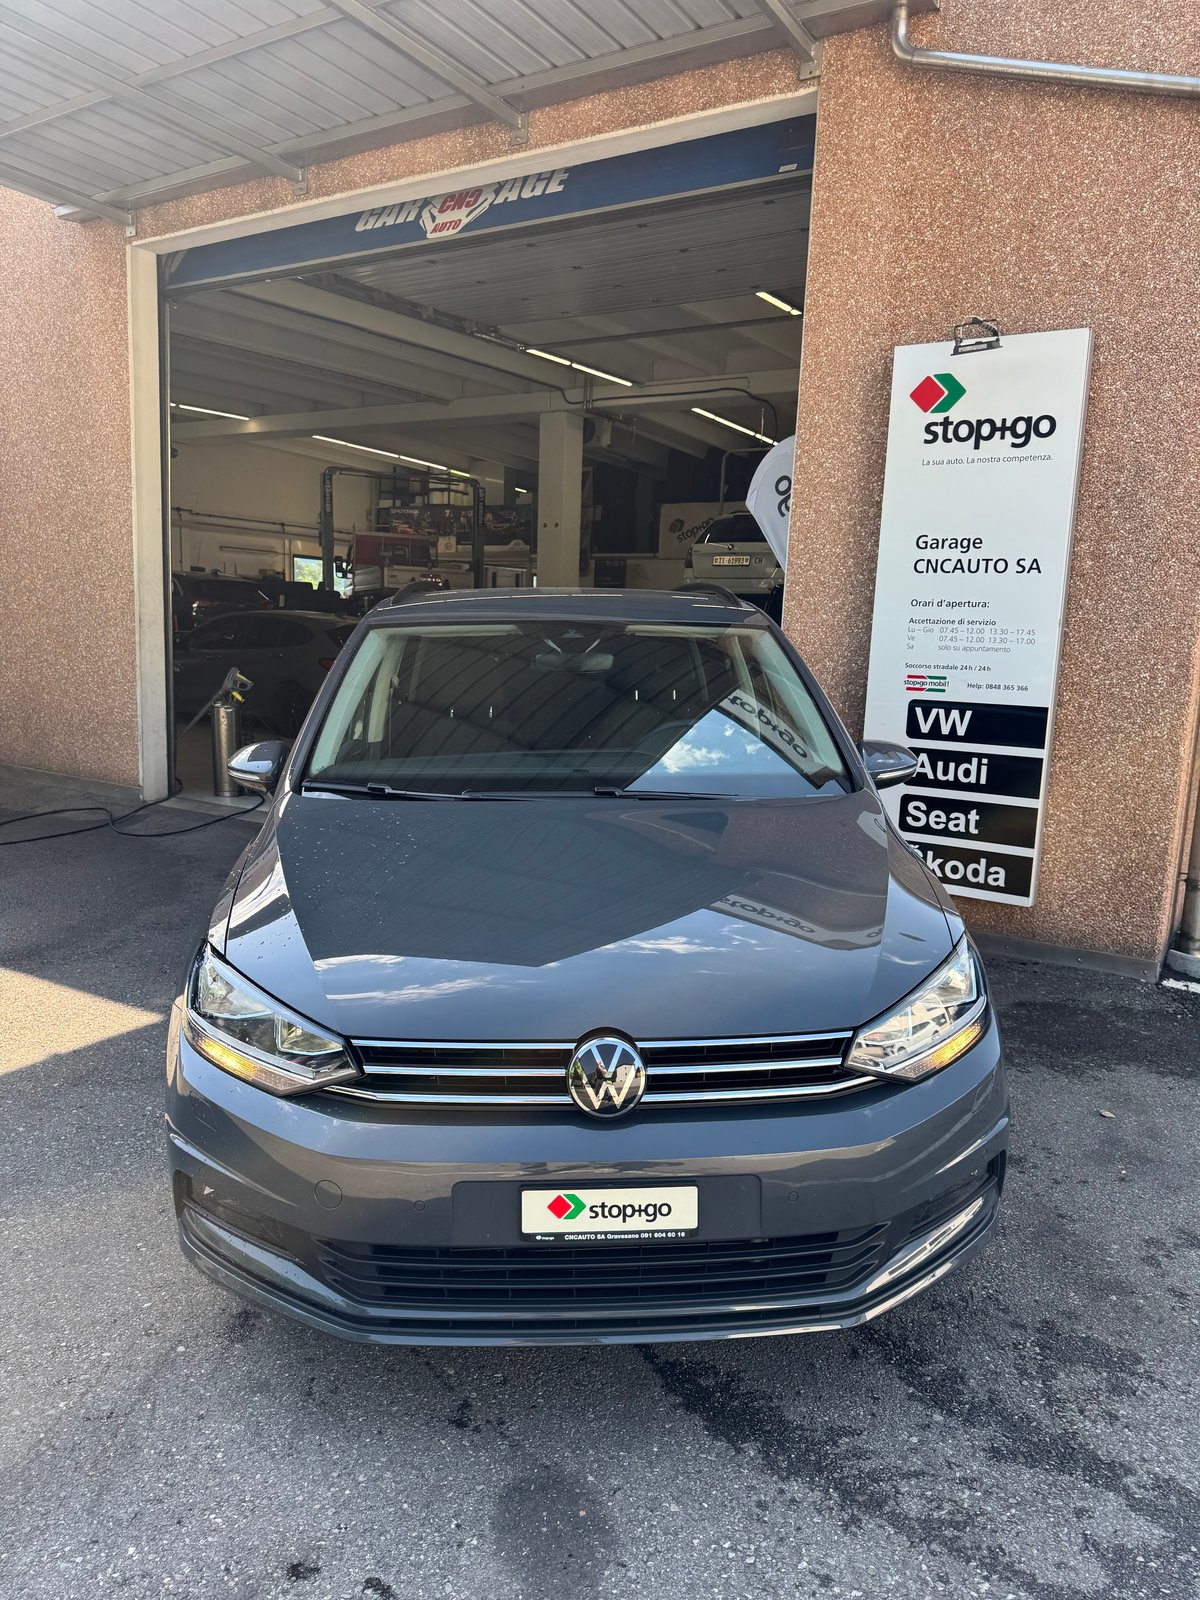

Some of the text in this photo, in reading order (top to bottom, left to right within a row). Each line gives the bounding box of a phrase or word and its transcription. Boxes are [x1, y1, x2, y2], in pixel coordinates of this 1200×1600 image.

[430, 218, 463, 235] AUTO
[923, 414, 1057, 451] stop+go
[966, 456, 975, 464] La
[976, 456, 1001, 464] nostra
[1002, 454, 1053, 464] competenza.
[915, 534, 984, 554] Garage
[913, 558, 1042, 574] CNCAUTO SA
[910, 598, 935, 608] Orari
[938, 635, 958, 643] 07.45
[1016, 637, 1036, 645] 17.00
[961, 645, 1011, 653] appuntamento
[933, 663, 959, 671] stradale
[967, 682, 983, 690] Help:
[1016, 684, 1029, 692] 366
[914, 707, 973, 737] VW
[912, 752, 989, 785] Audi
[905, 800, 980, 835] Seat
[589, 1201, 672, 1223] stop+go
